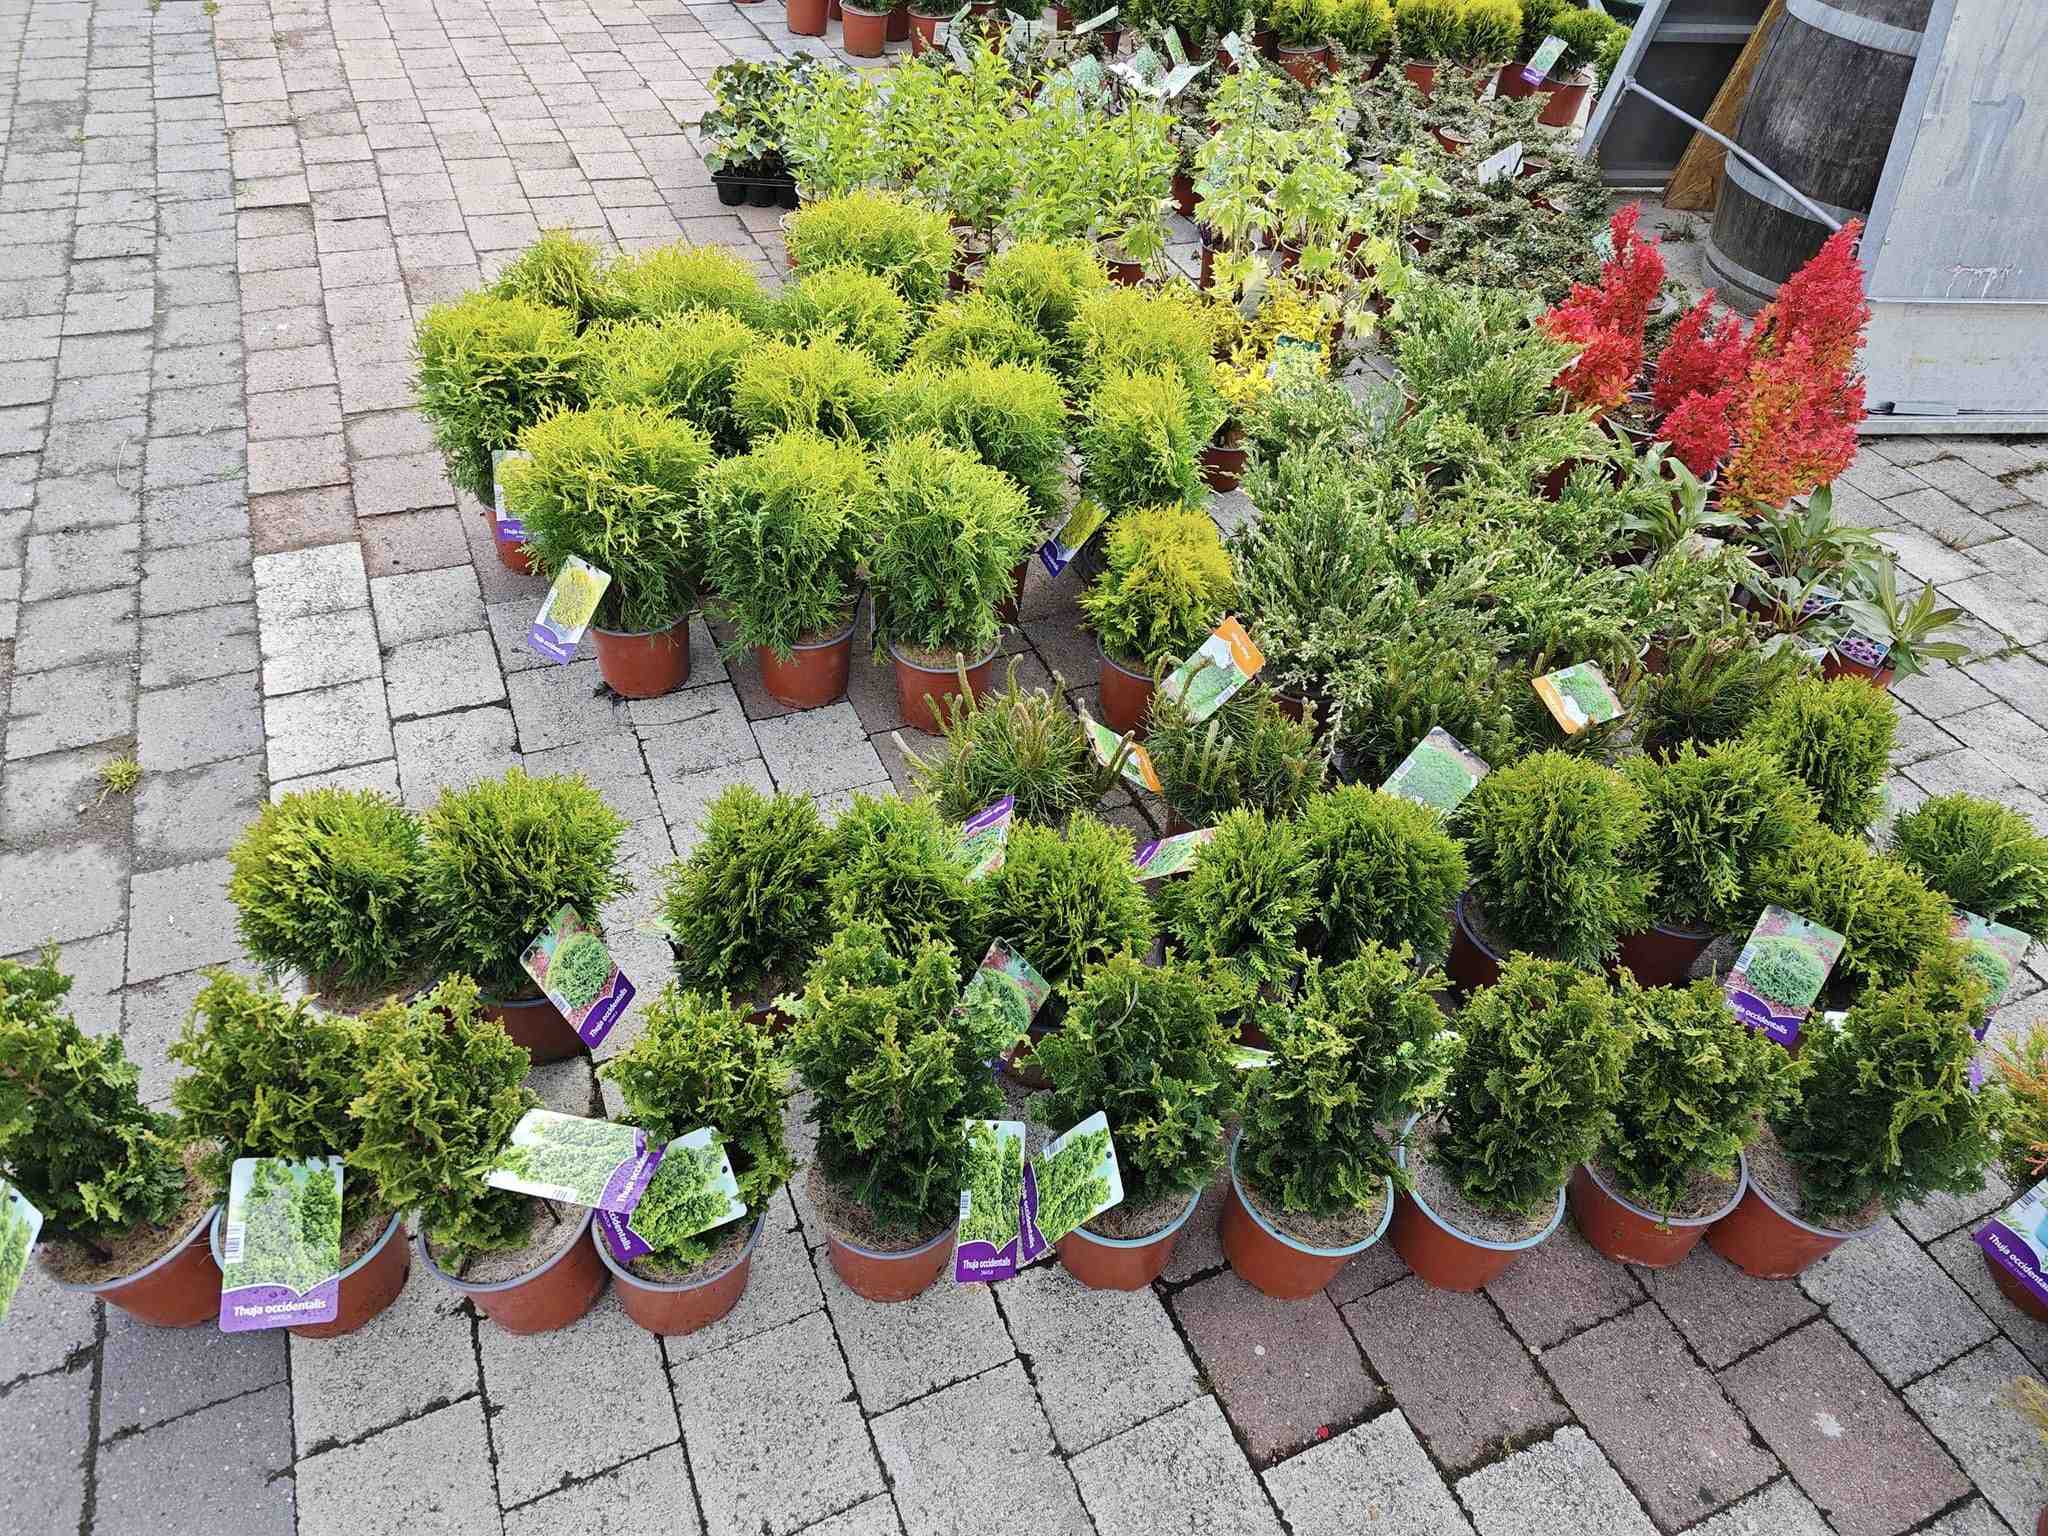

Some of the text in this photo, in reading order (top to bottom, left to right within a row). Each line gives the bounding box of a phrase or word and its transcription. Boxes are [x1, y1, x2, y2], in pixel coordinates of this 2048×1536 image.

[607, 1209, 632, 1251] ccidentalis
[1988, 1233, 2011, 1255] Thuja
[233, 1306, 263, 1318] Thuja
[265, 1299, 327, 1314] occidentalis
